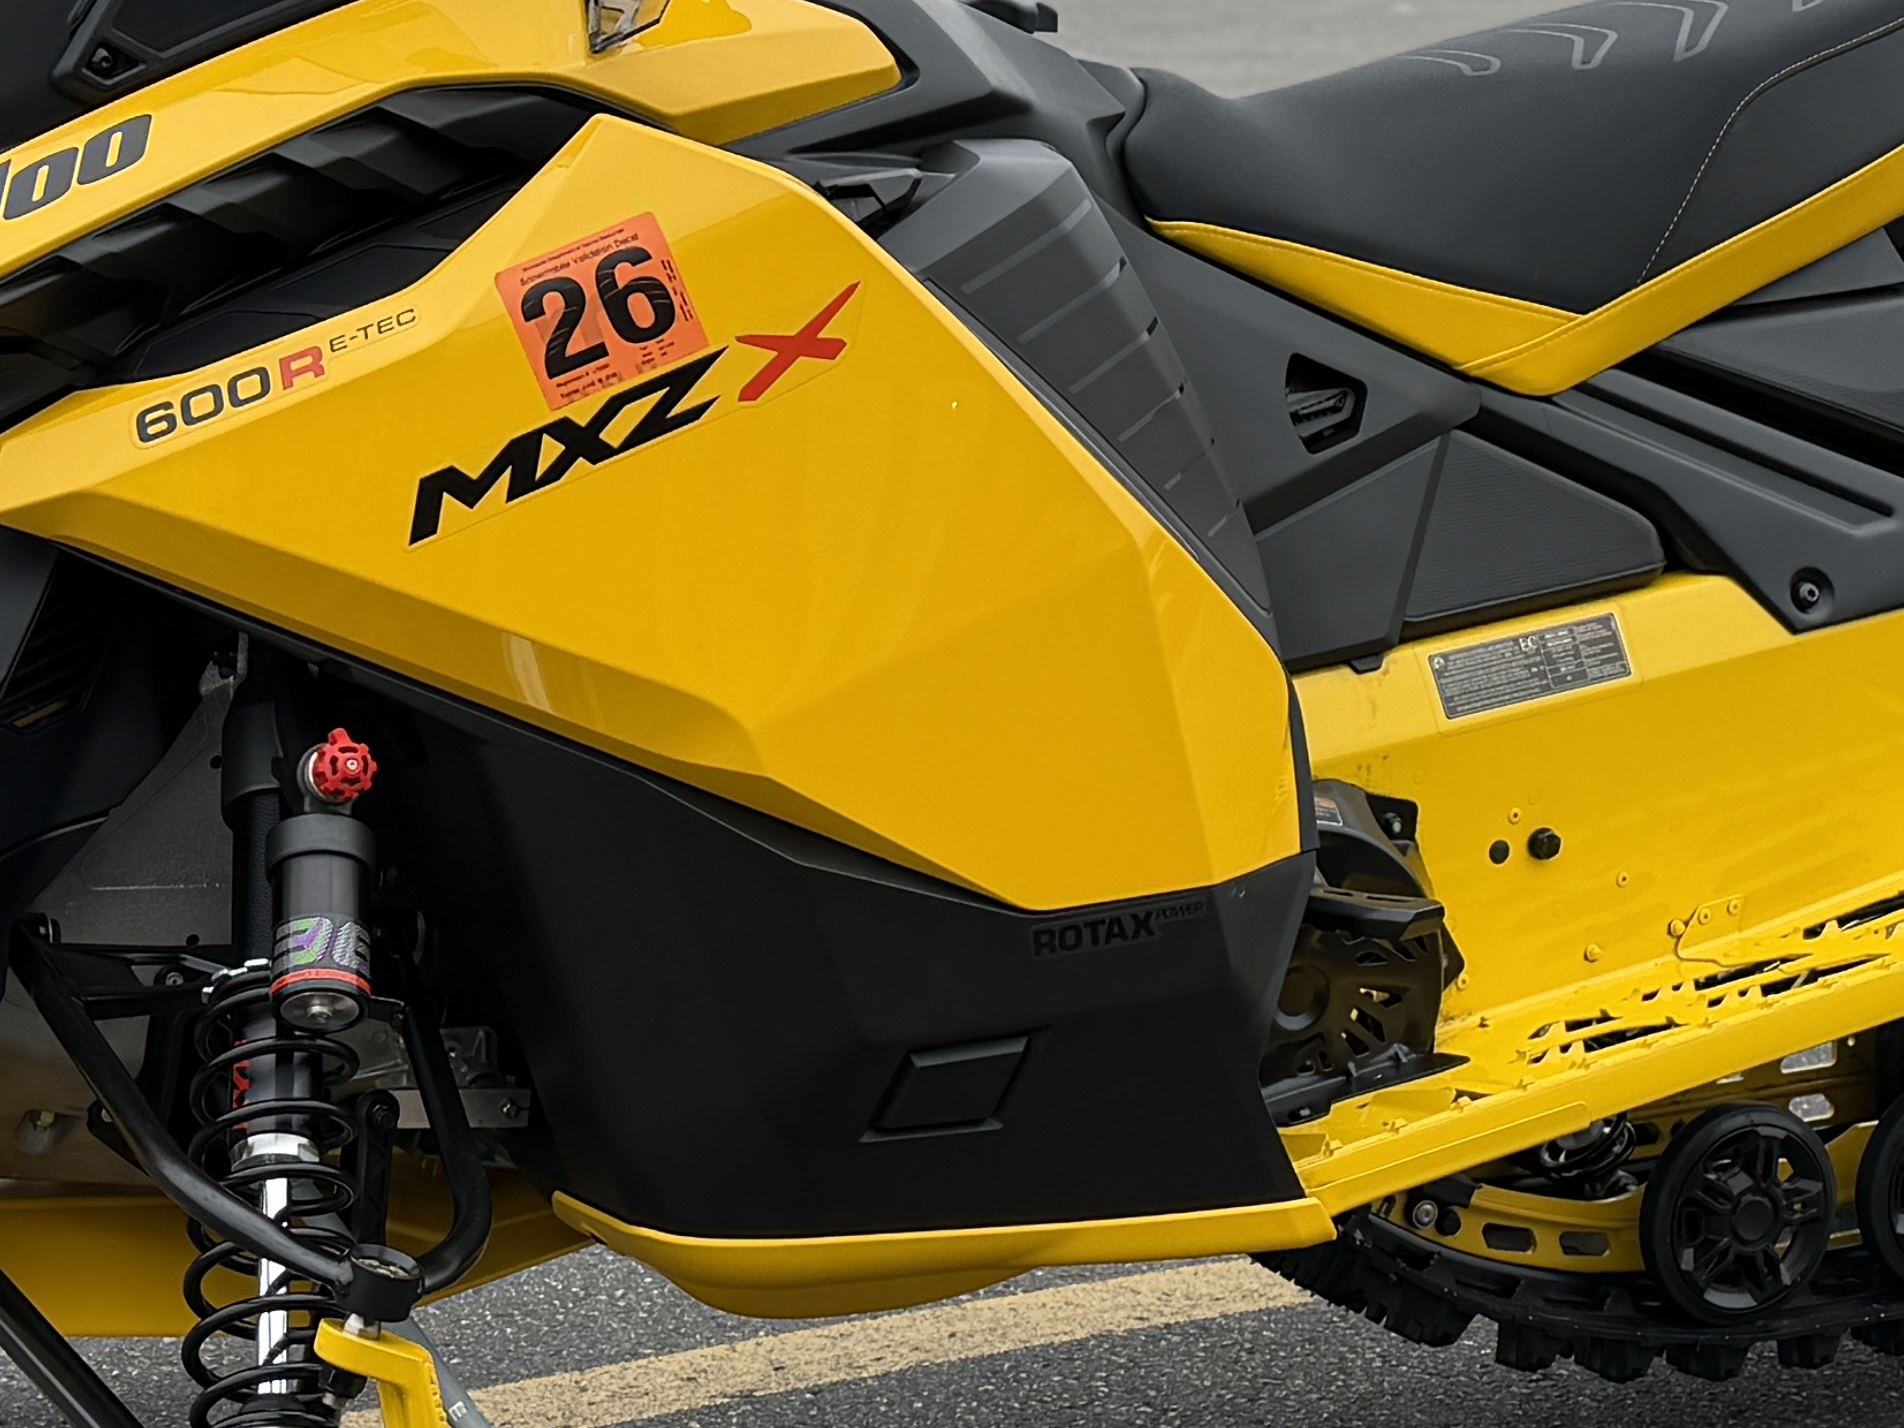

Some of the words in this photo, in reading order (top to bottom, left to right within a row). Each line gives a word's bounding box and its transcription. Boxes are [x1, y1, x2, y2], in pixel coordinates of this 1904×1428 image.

[615, 232, 640, 250] Decal
[328, 307, 418, 354] E-TEC
[521, 245, 676, 380] 26
[408, 345, 730, 547] MXZ
[736, 281, 862, 404] X
[1032, 908, 1158, 958] ROTAX
[1155, 900, 1205, 924] POWER
